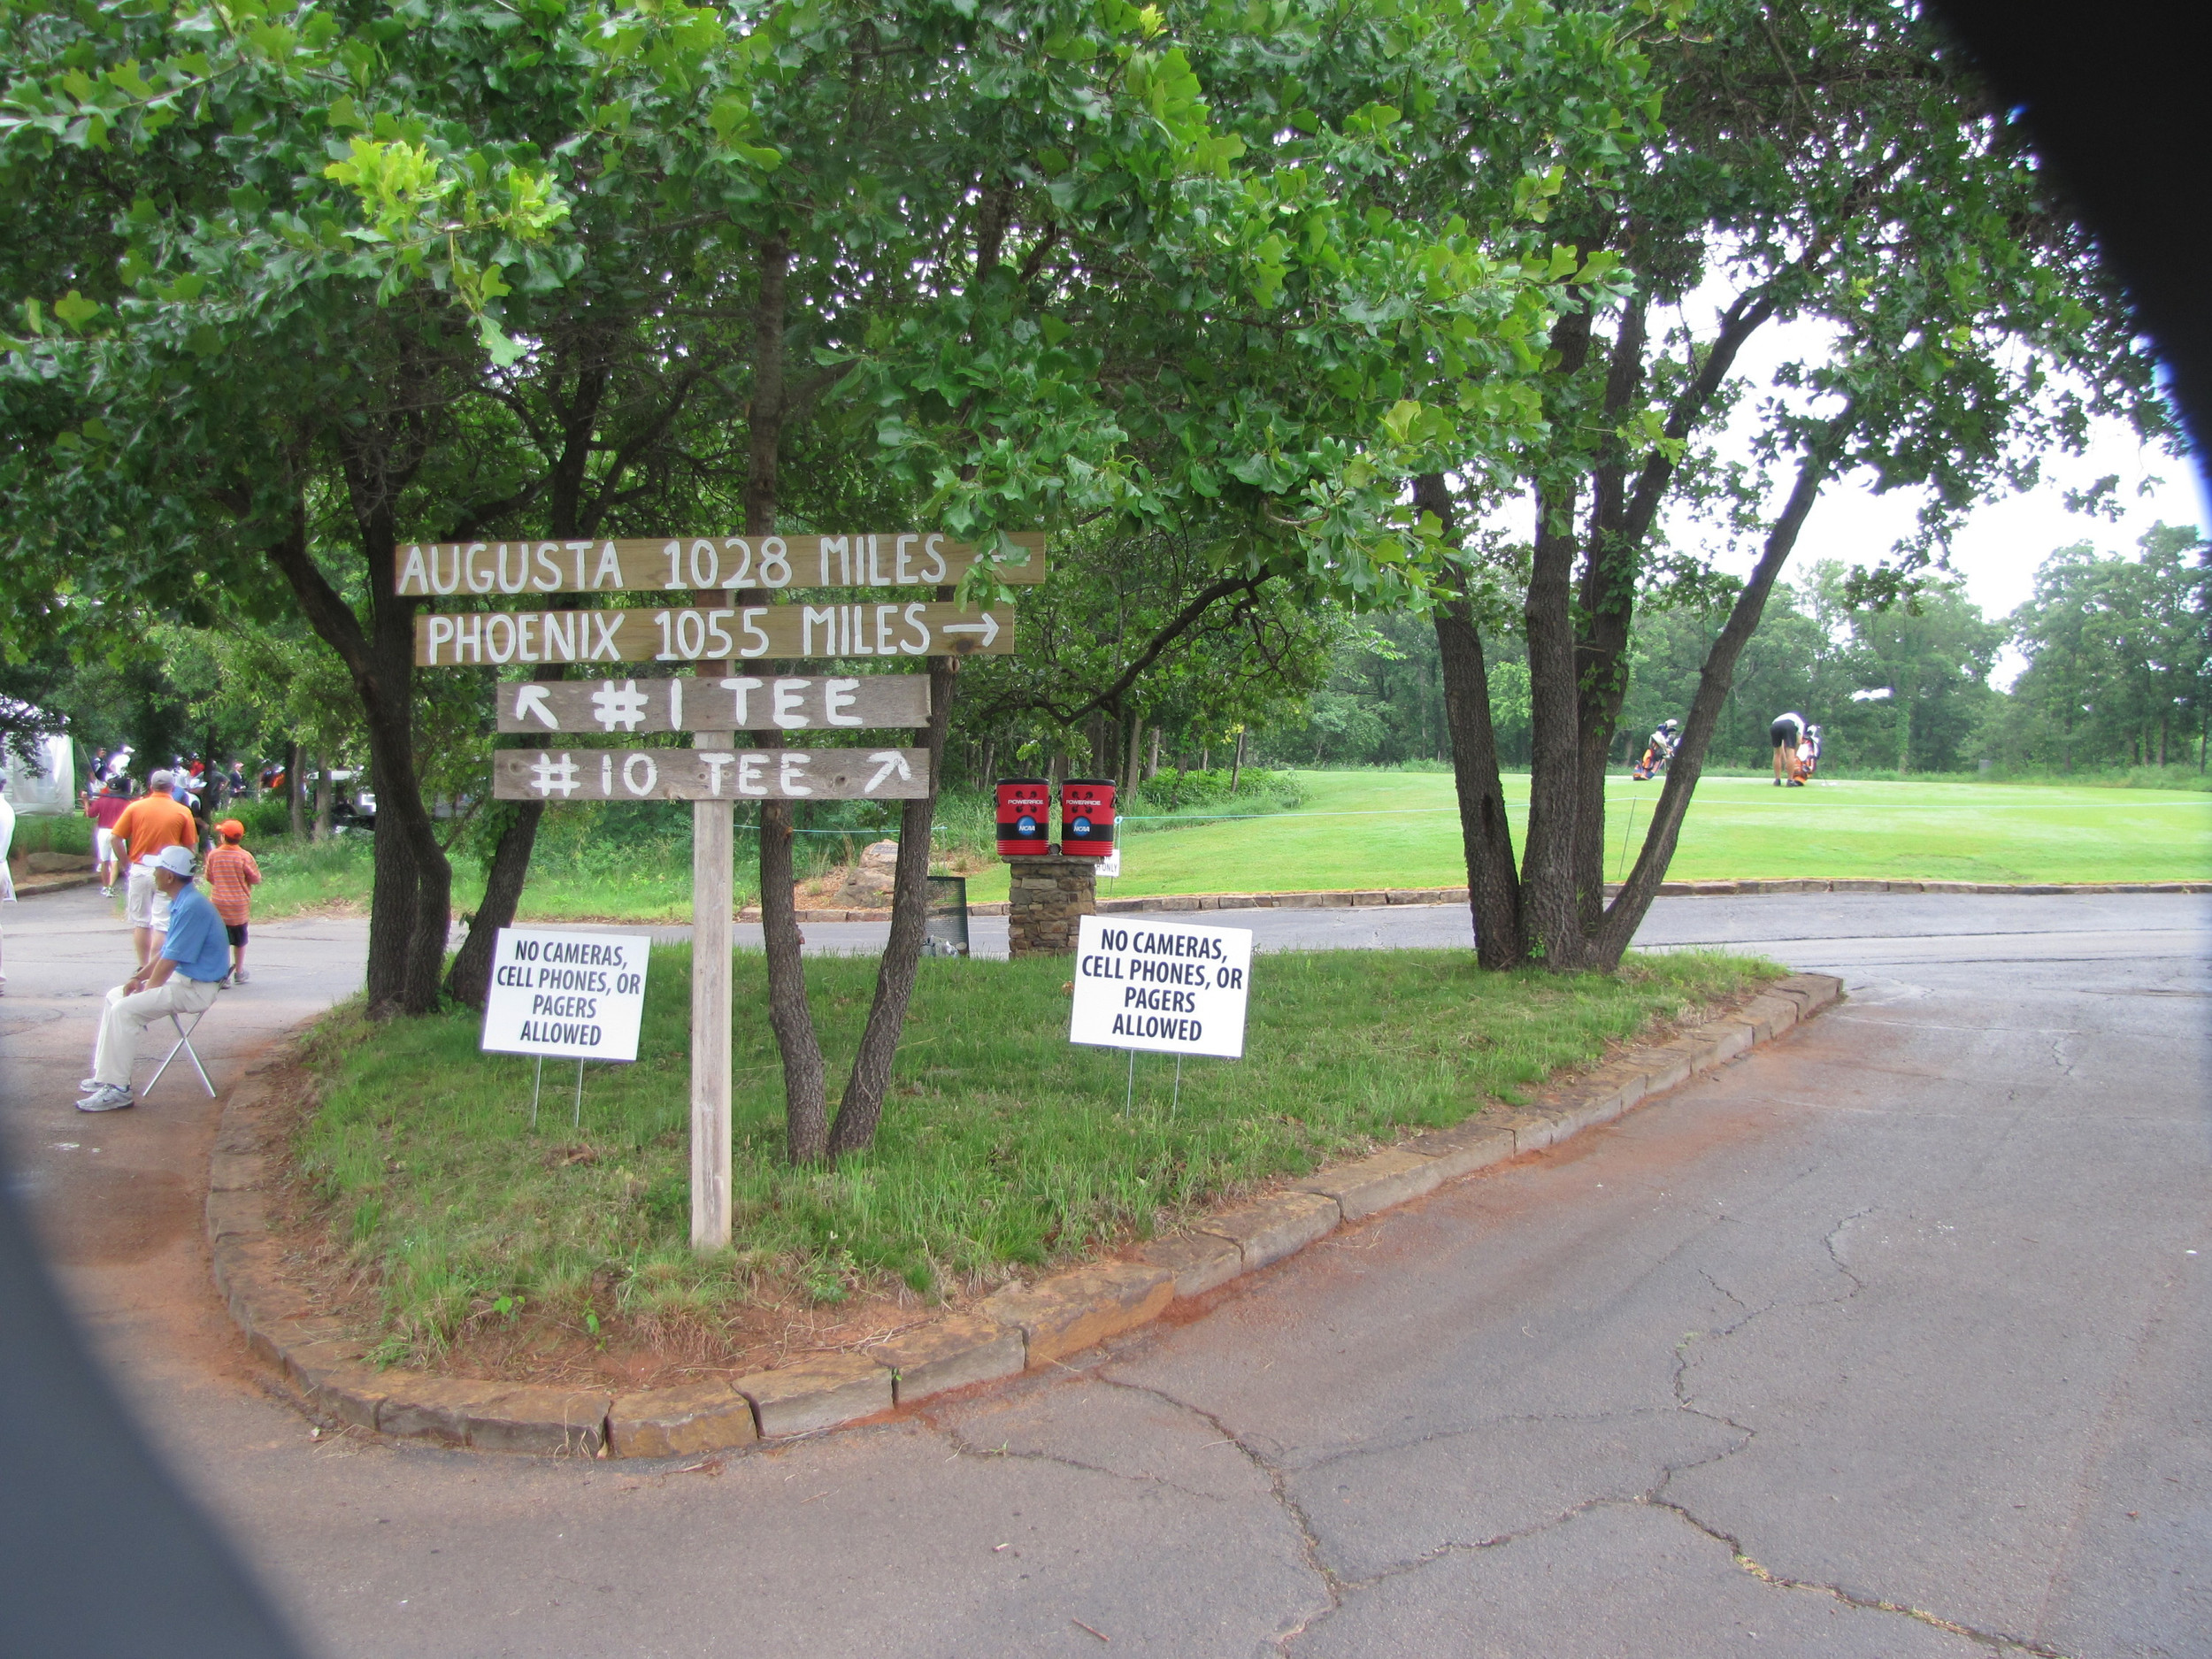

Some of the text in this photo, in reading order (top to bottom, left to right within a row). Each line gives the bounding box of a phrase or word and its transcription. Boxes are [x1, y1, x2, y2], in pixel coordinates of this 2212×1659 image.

[398, 534, 948, 595] AUGUSTA 1028 MILES
[429, 603, 931, 665] PHOENIX 1055 MILES
[720, 678, 864, 728] TEE
[699, 753, 812, 796] TEE
[1102, 863, 1118, 872] ONLY
[515, 940, 628, 971] NO CAMERAS,
[1101, 928, 1228, 964] NO CAMERAS,
[497, 965, 641, 996] CELL PHONES, OR
[1082, 955, 1243, 990] CELL PHONES, OR
[533, 995, 597, 1018] PAGERS
[1124, 987, 1195, 1013] PAGERS
[520, 1020, 602, 1046] ALLOWED
[1112, 1013, 1202, 1041] ALLOWED
